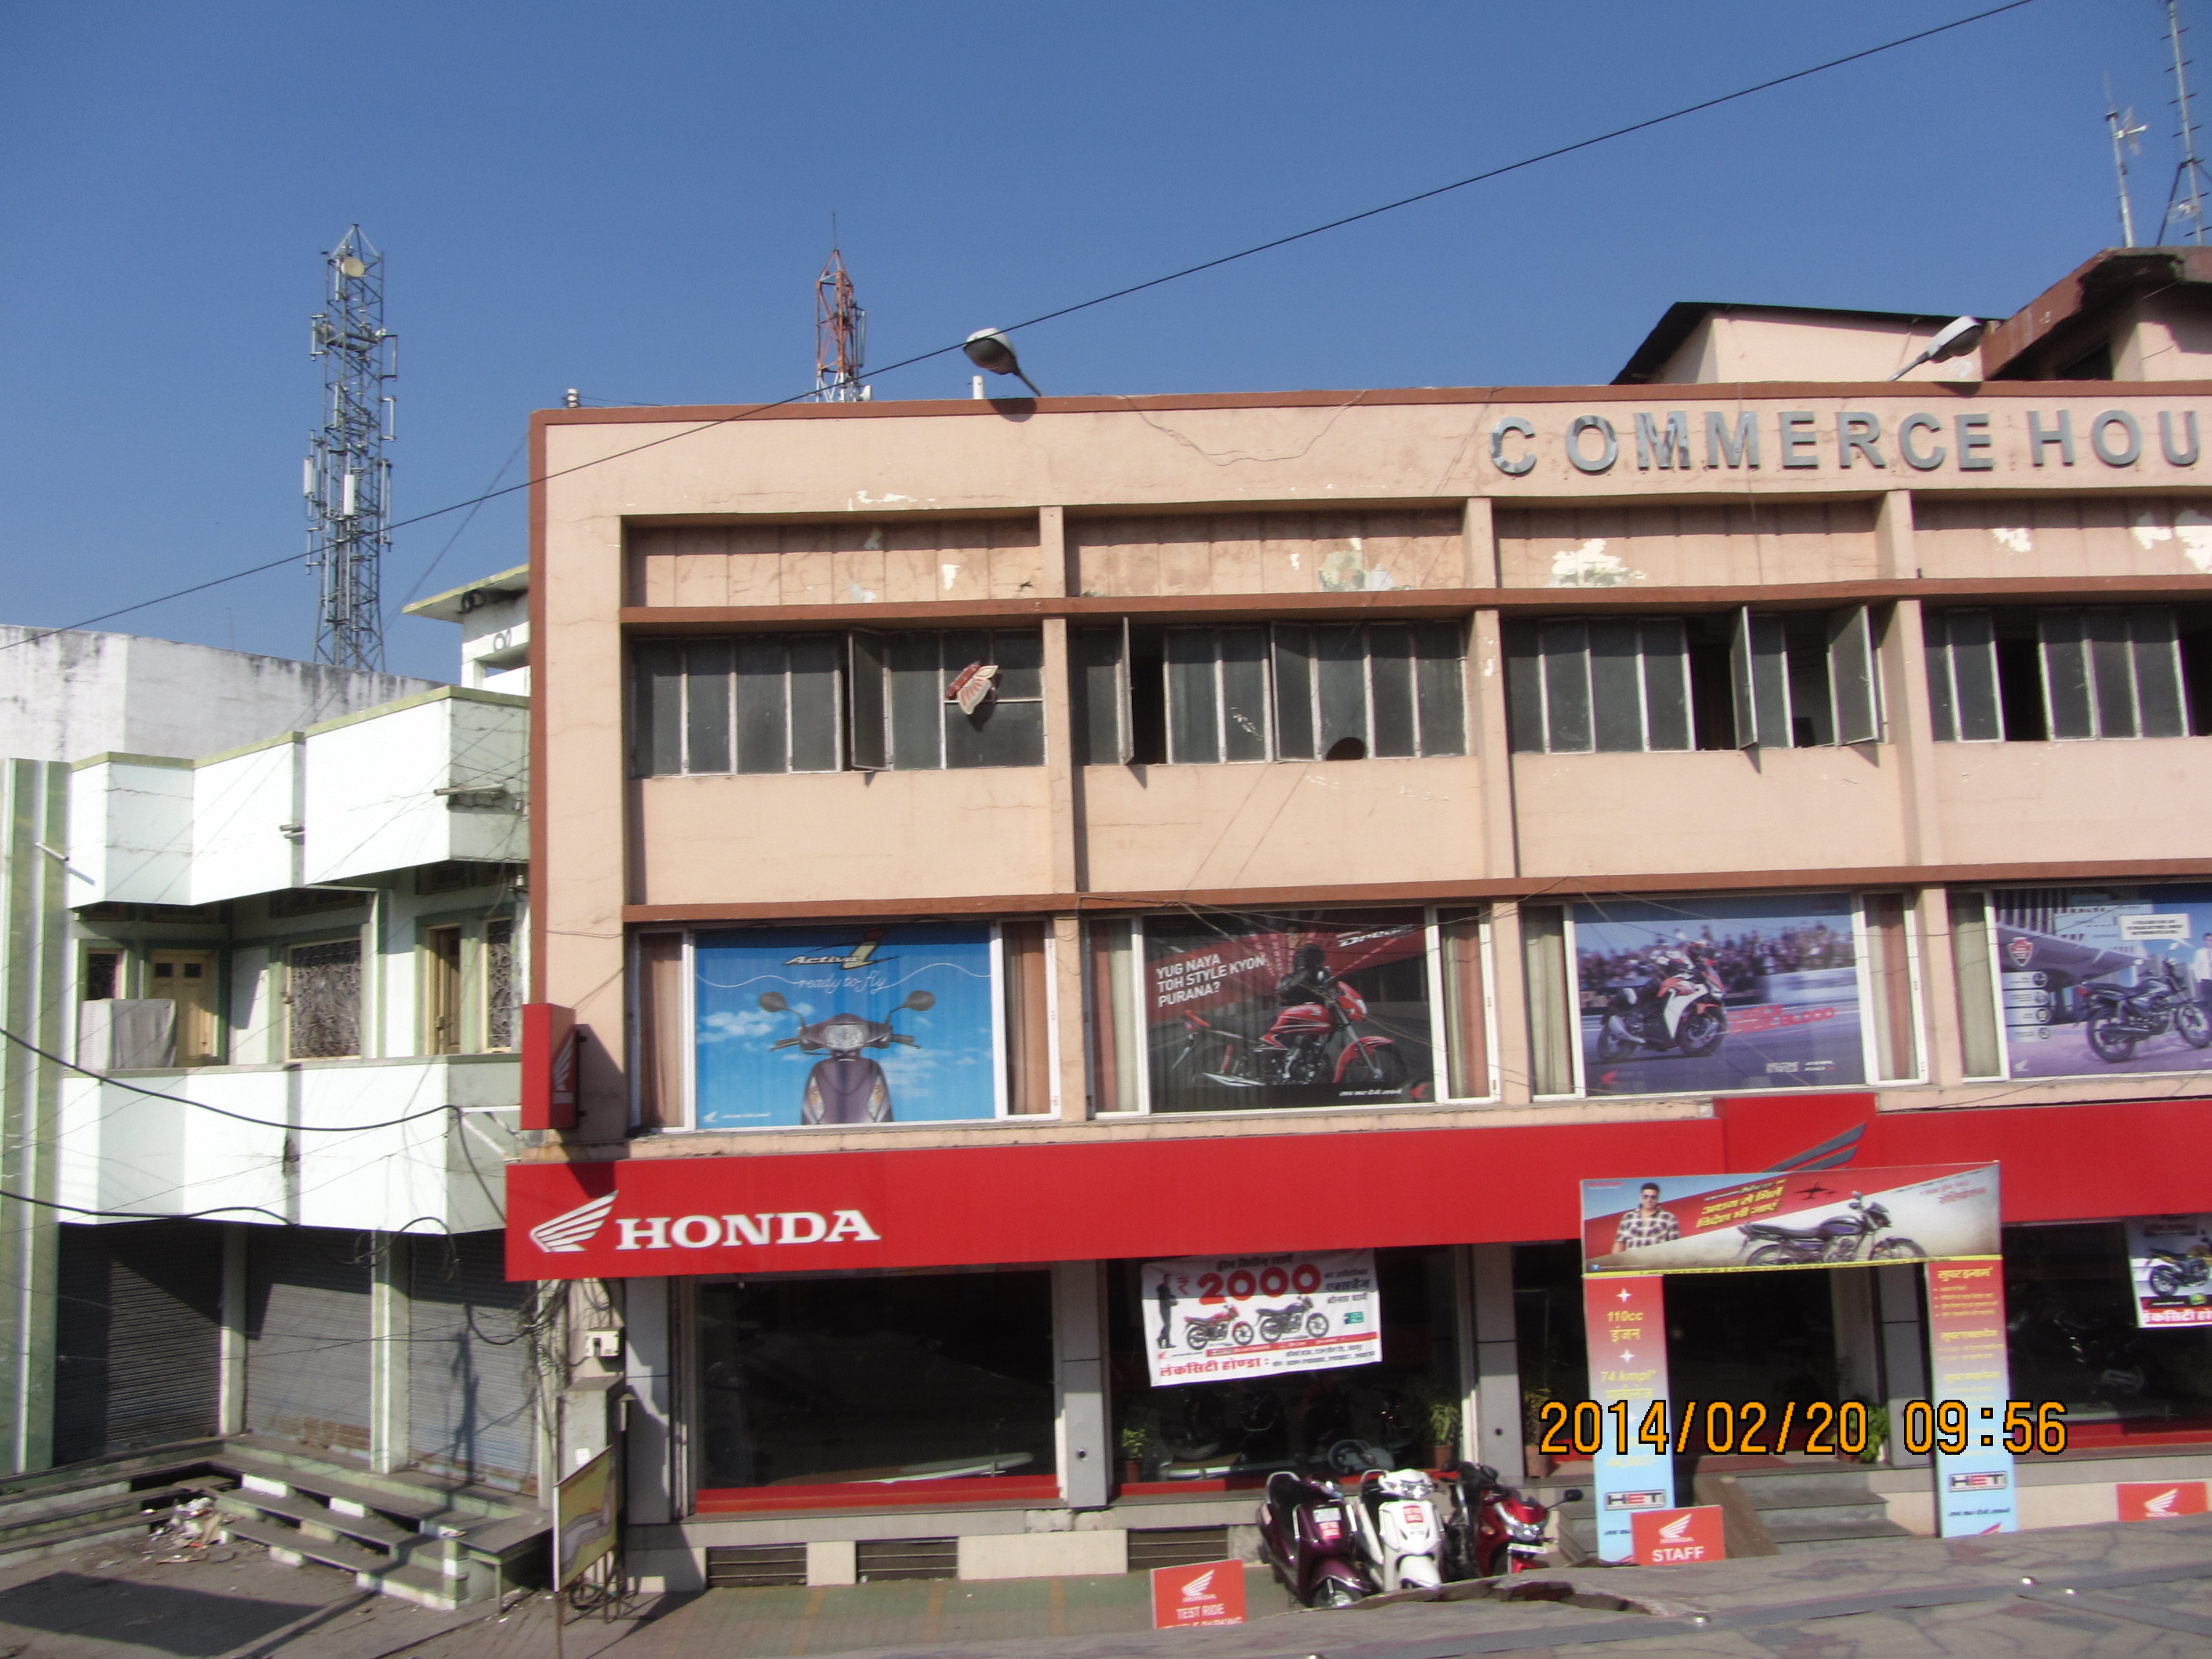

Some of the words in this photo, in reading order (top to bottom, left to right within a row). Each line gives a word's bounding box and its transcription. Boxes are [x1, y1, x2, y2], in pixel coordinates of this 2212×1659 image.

[1489, 410, 1995, 474] COMMERCE
[783, 954, 860, 965] Activa
[1155, 962, 1185, 980] YUG
[1185, 953, 1221, 973] NAYA
[797, 973, 841, 994] ready
[843, 976, 862, 988] to
[1156, 976, 1185, 994] TOH
[1185, 965, 1228, 987] STYLE
[1229, 956, 1265, 975] KYON
[1157, 981, 1221, 1009] PURANA?
[615, 1209, 882, 1251] HONDA
[1196, 1263, 1321, 1306] 2000
[1606, 1309, 1644, 1322] 110cc
[1601, 1371, 1617, 1382] 74
[1950, 1473, 2005, 1487] HET
[1607, 1492, 1664, 1506] HET
[1651, 1545, 1705, 1562] STAFF
[1176, 1606, 1201, 1620] TEST
[1200, 1603, 1225, 1617] RIDE
